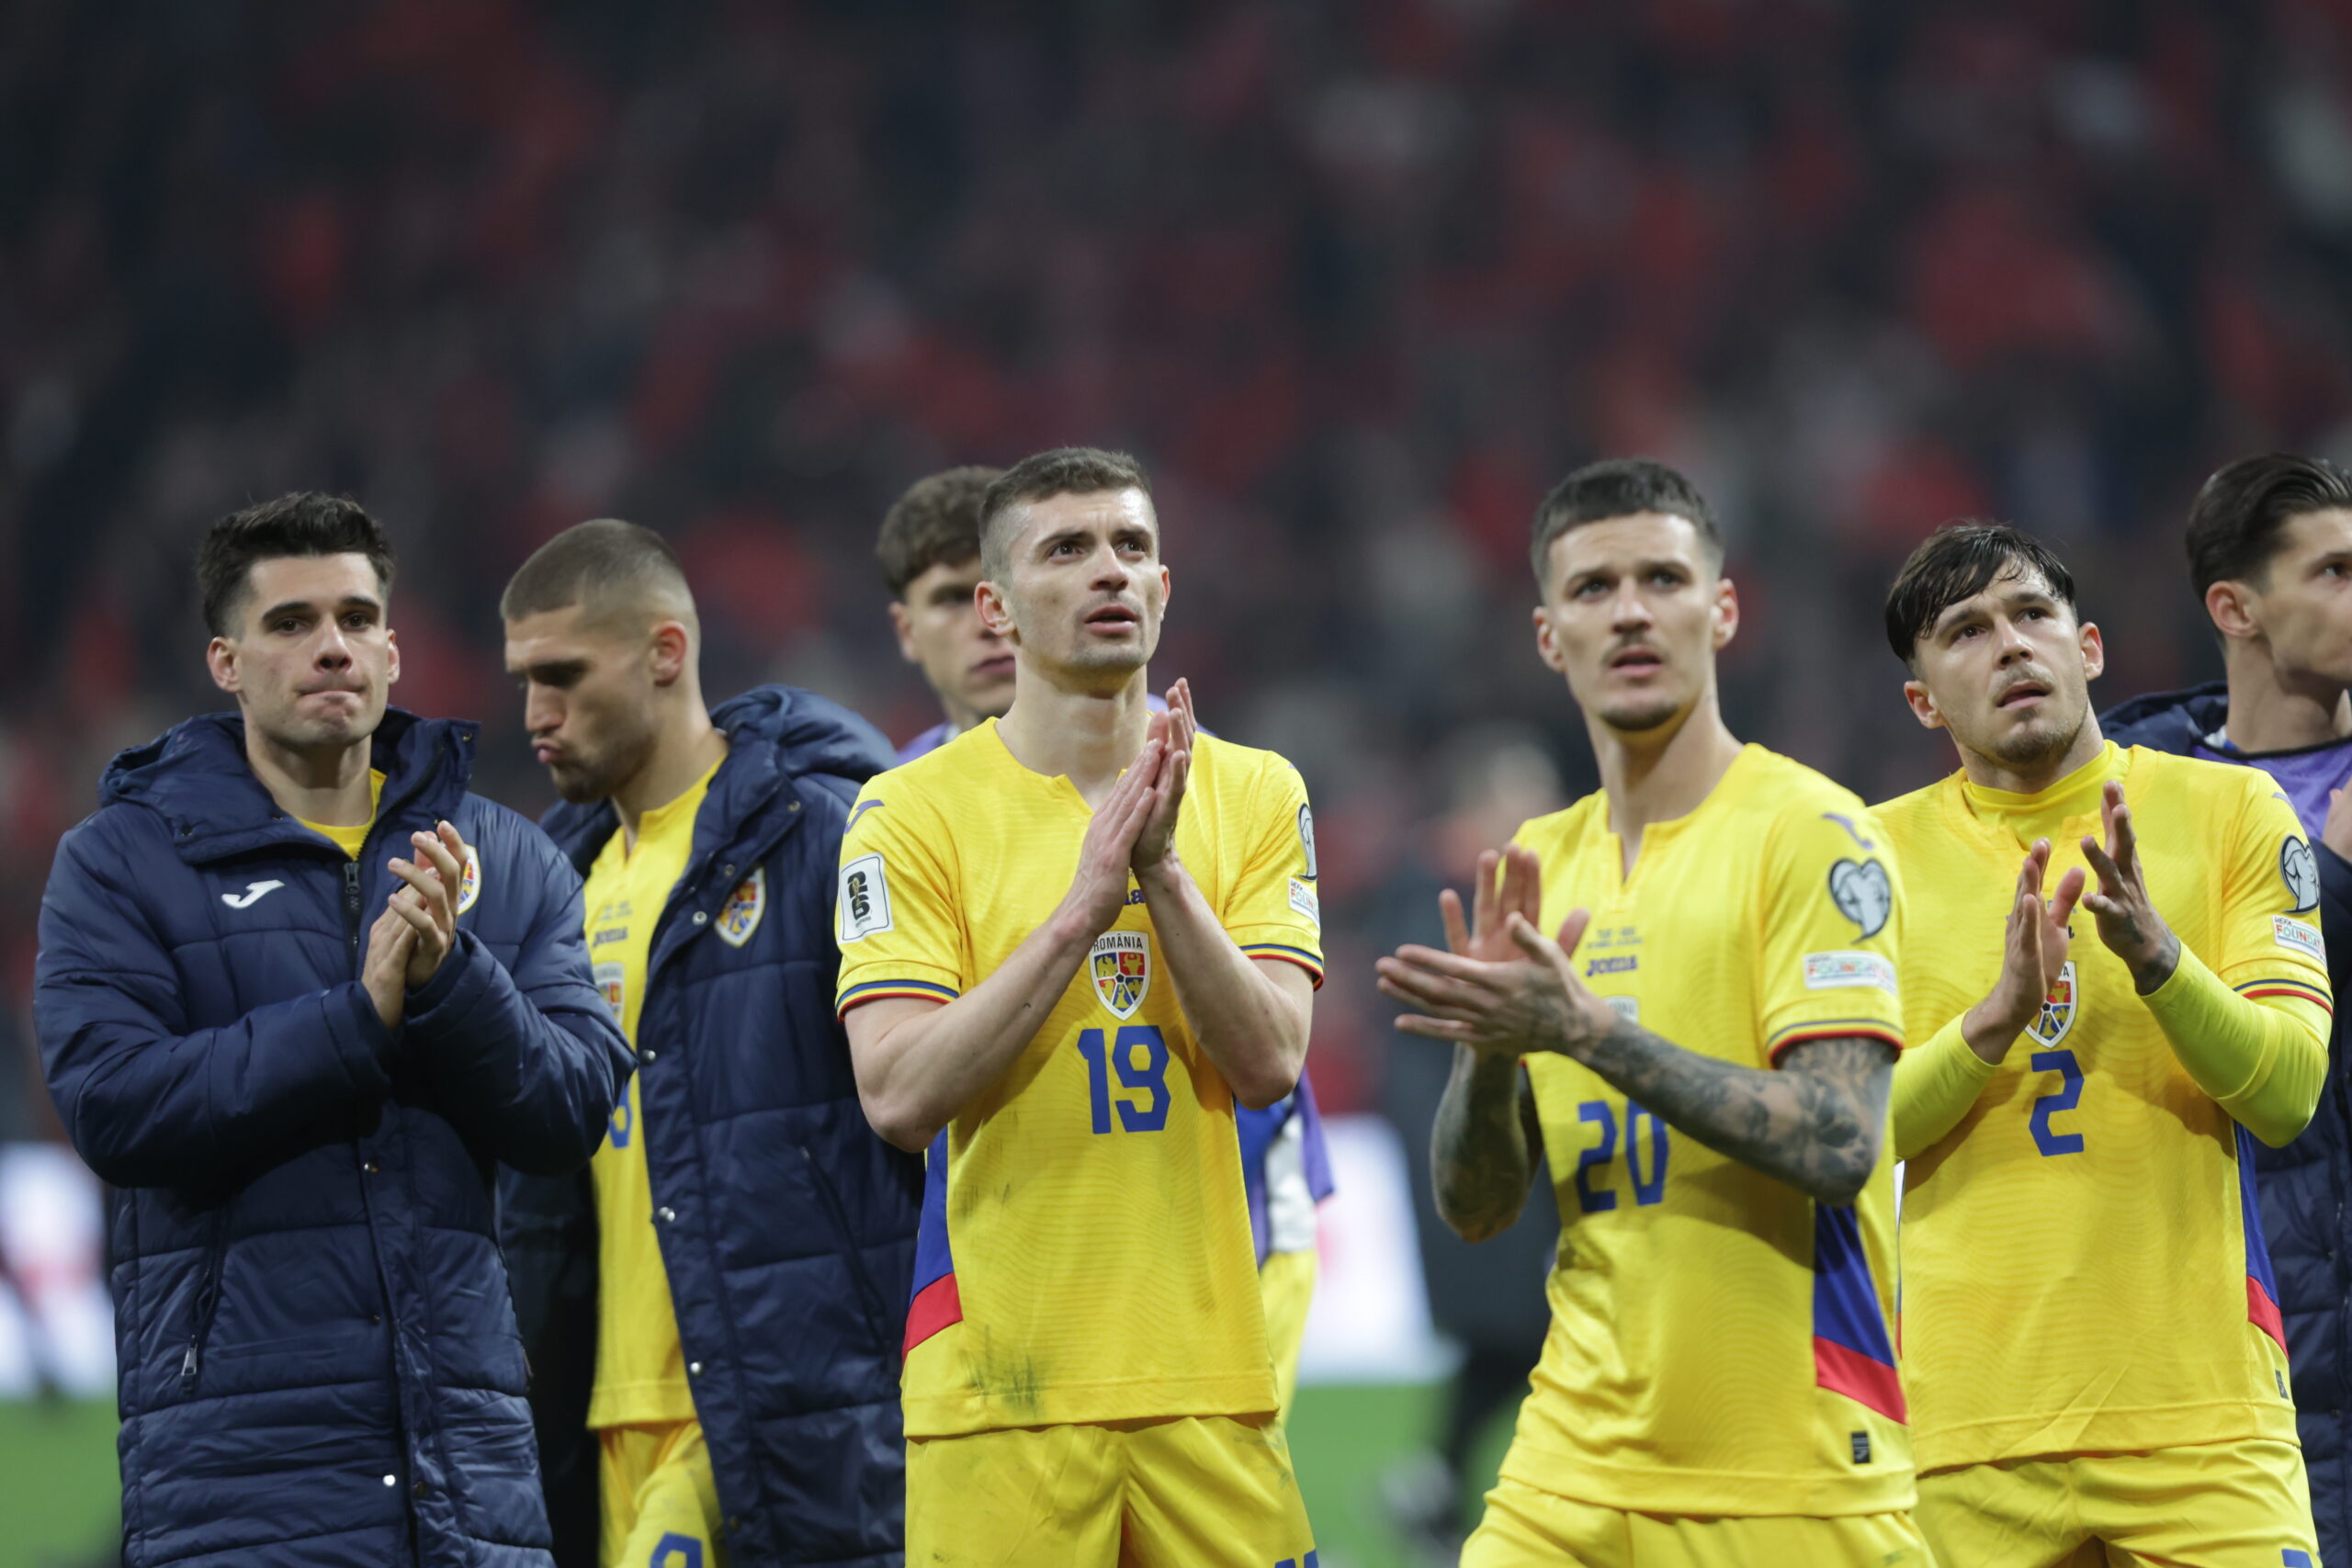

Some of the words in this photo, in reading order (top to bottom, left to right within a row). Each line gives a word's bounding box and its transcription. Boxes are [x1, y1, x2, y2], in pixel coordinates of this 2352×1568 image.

[1077, 1025, 1171, 1134] 19
[2029, 1049, 2085, 1157] 2
[1576, 1099, 1669, 1213] 20
